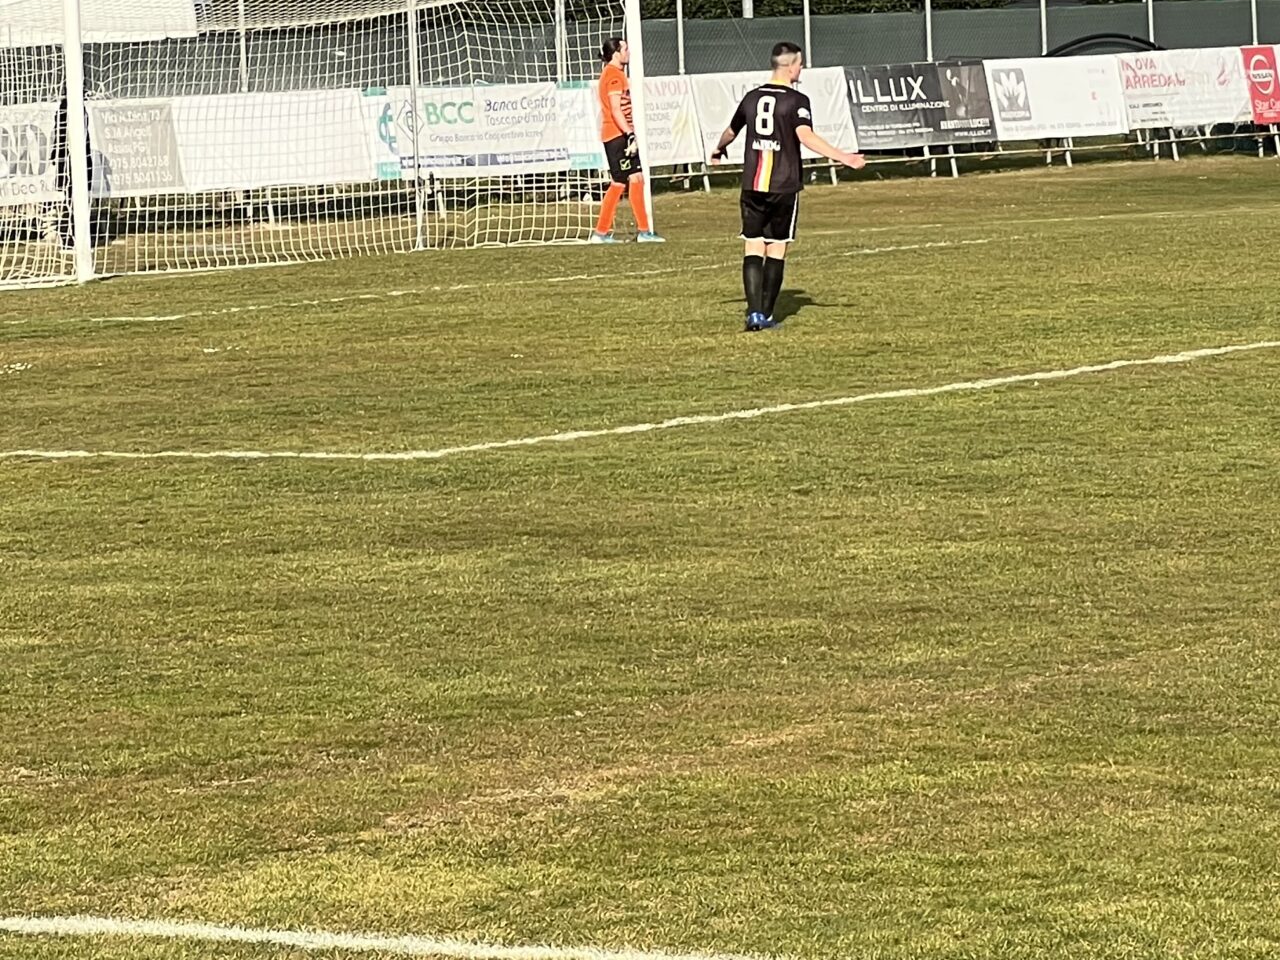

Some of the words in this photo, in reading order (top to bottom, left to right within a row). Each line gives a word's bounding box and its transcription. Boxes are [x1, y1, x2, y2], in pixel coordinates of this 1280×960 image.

[1252, 72, 1273, 80] NISSAN
[848, 75, 928, 104] ILLUX
[424, 101, 475, 125] BCC
[484, 99, 518, 112] Banca
[520, 95, 557, 110] Centro
[646, 112, 672, 122] TAZIONE
[755, 95, 777, 136] 8
[861, 104, 889, 113] CENTRO
[890, 103, 898, 111] DI
[899, 100, 951, 111] ILLUMINAZIONE
